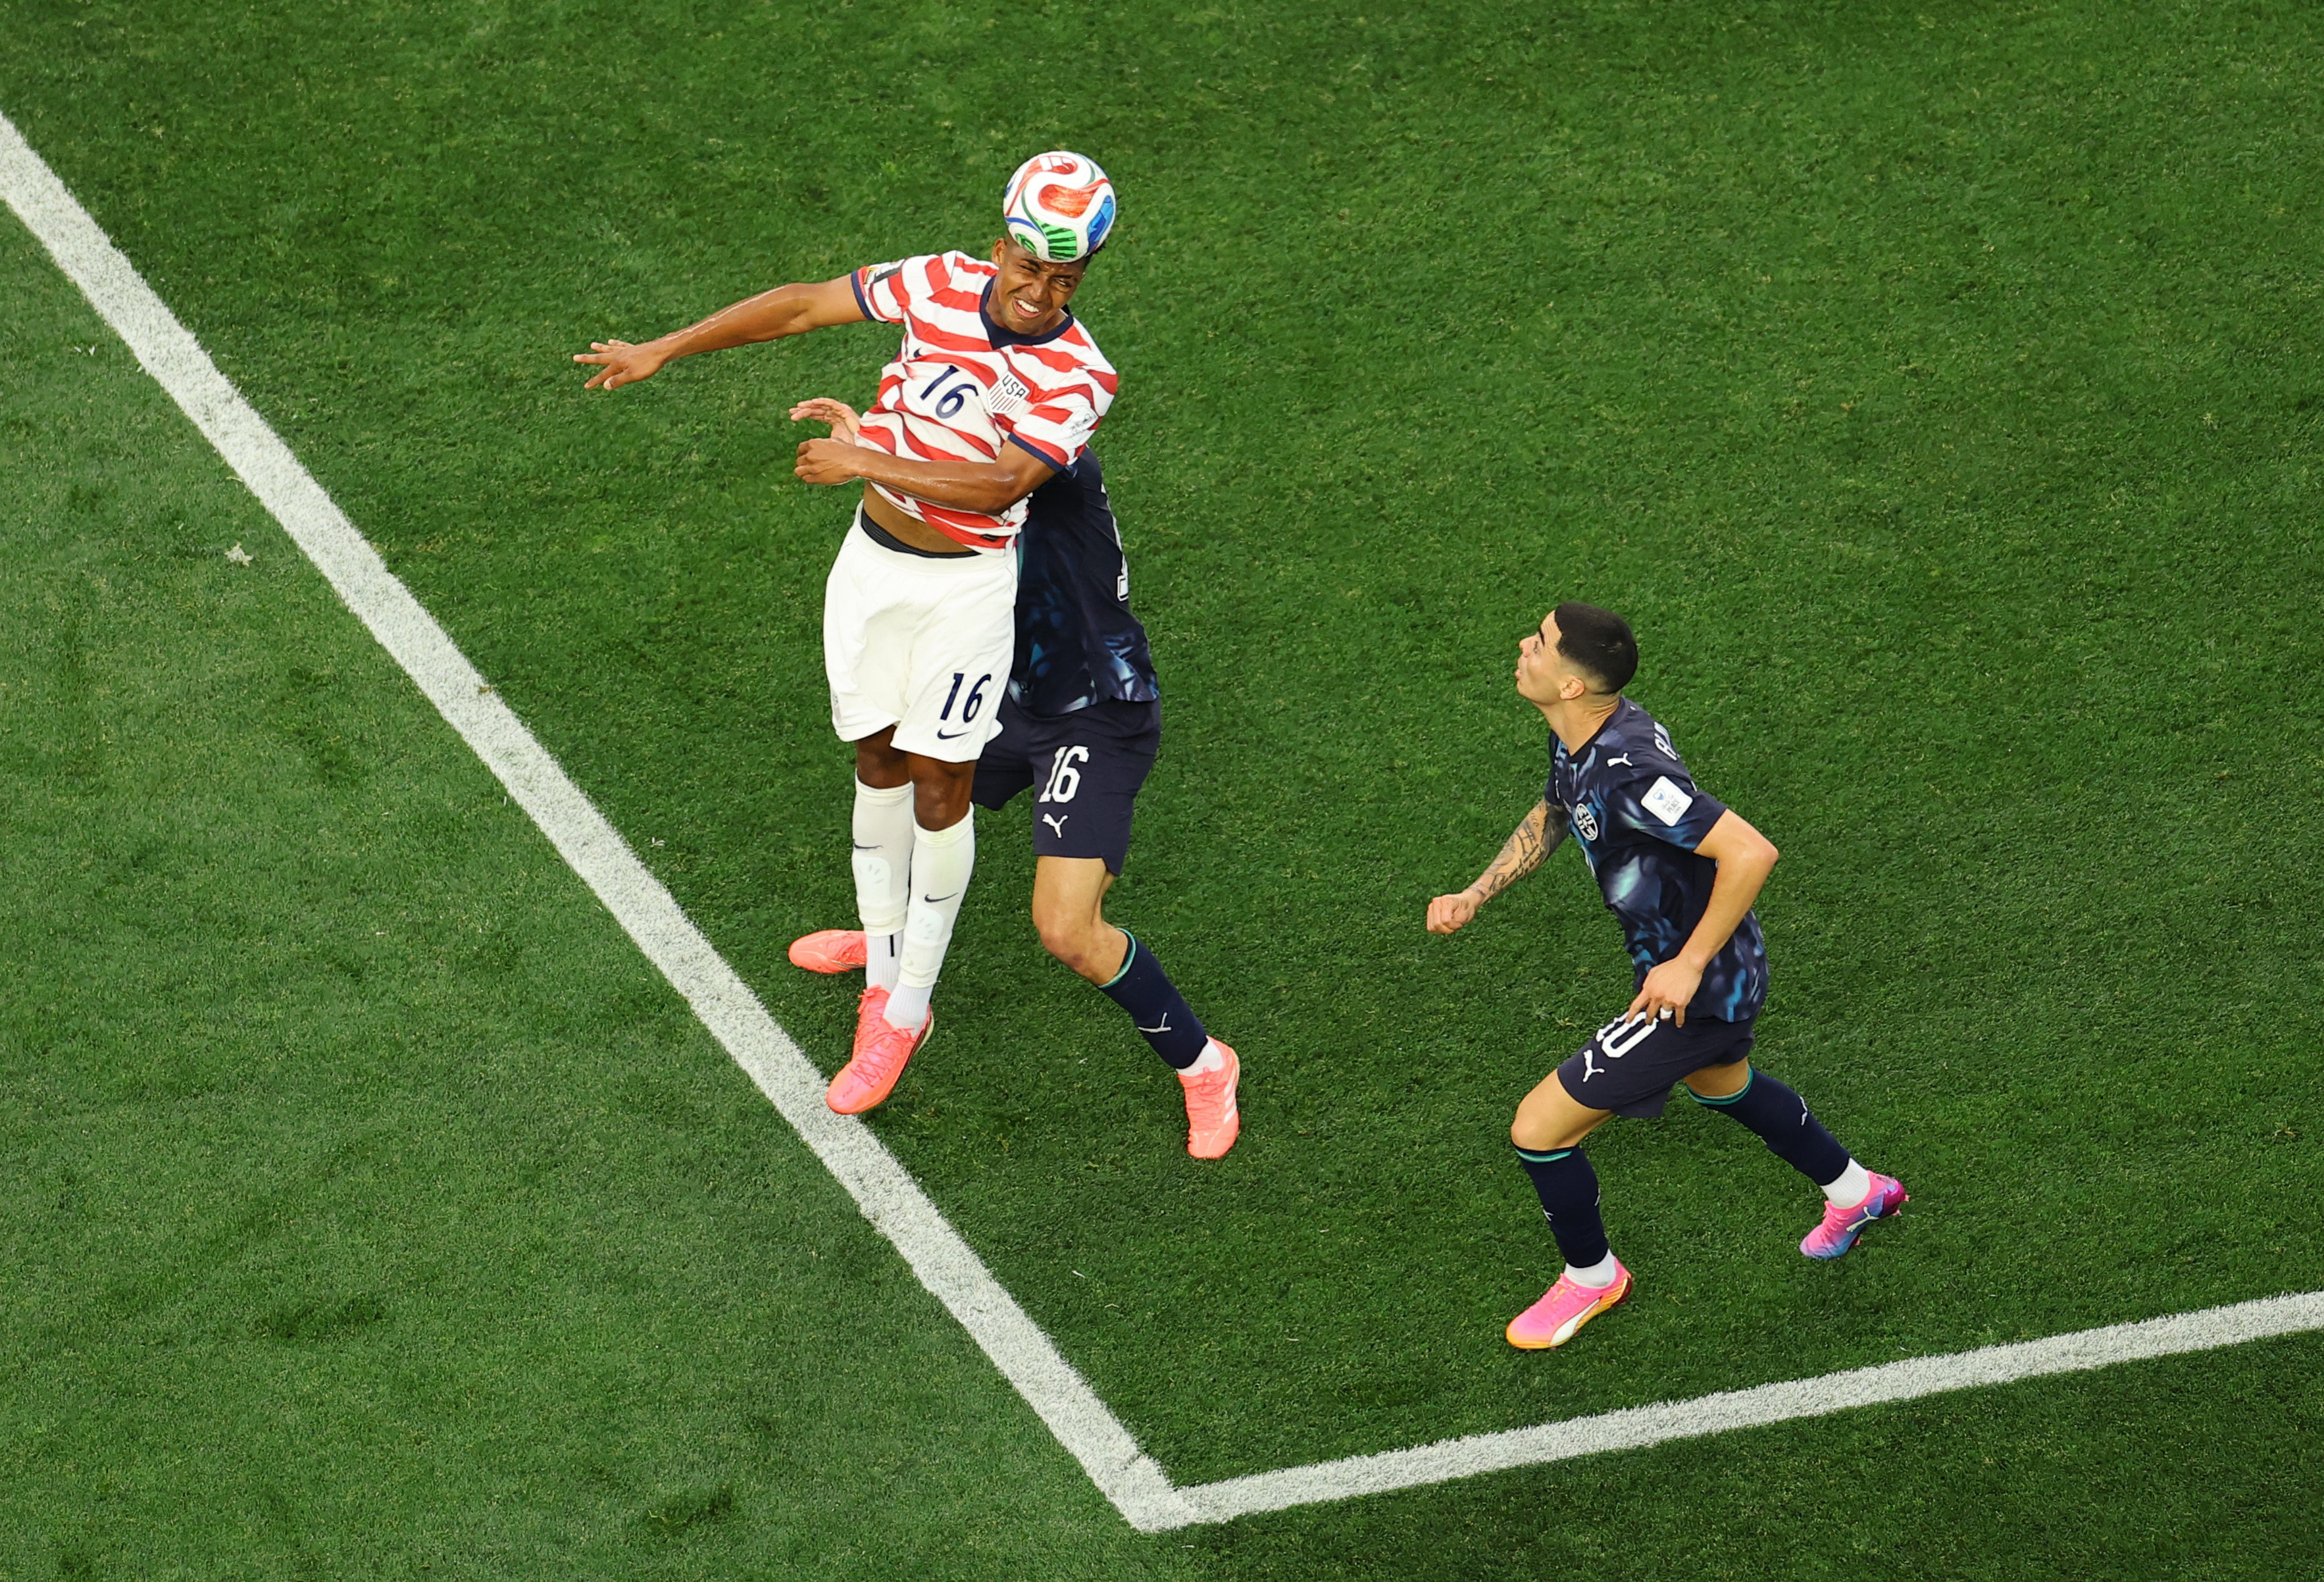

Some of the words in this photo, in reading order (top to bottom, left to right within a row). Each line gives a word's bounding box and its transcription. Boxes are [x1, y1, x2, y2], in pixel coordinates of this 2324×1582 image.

[920, 365, 978, 419] 16
[1001, 374, 1026, 398] USA
[940, 673, 992, 723] 16
[1038, 745, 1090, 804] 16
[1596, 1011, 1659, 1059] 10
